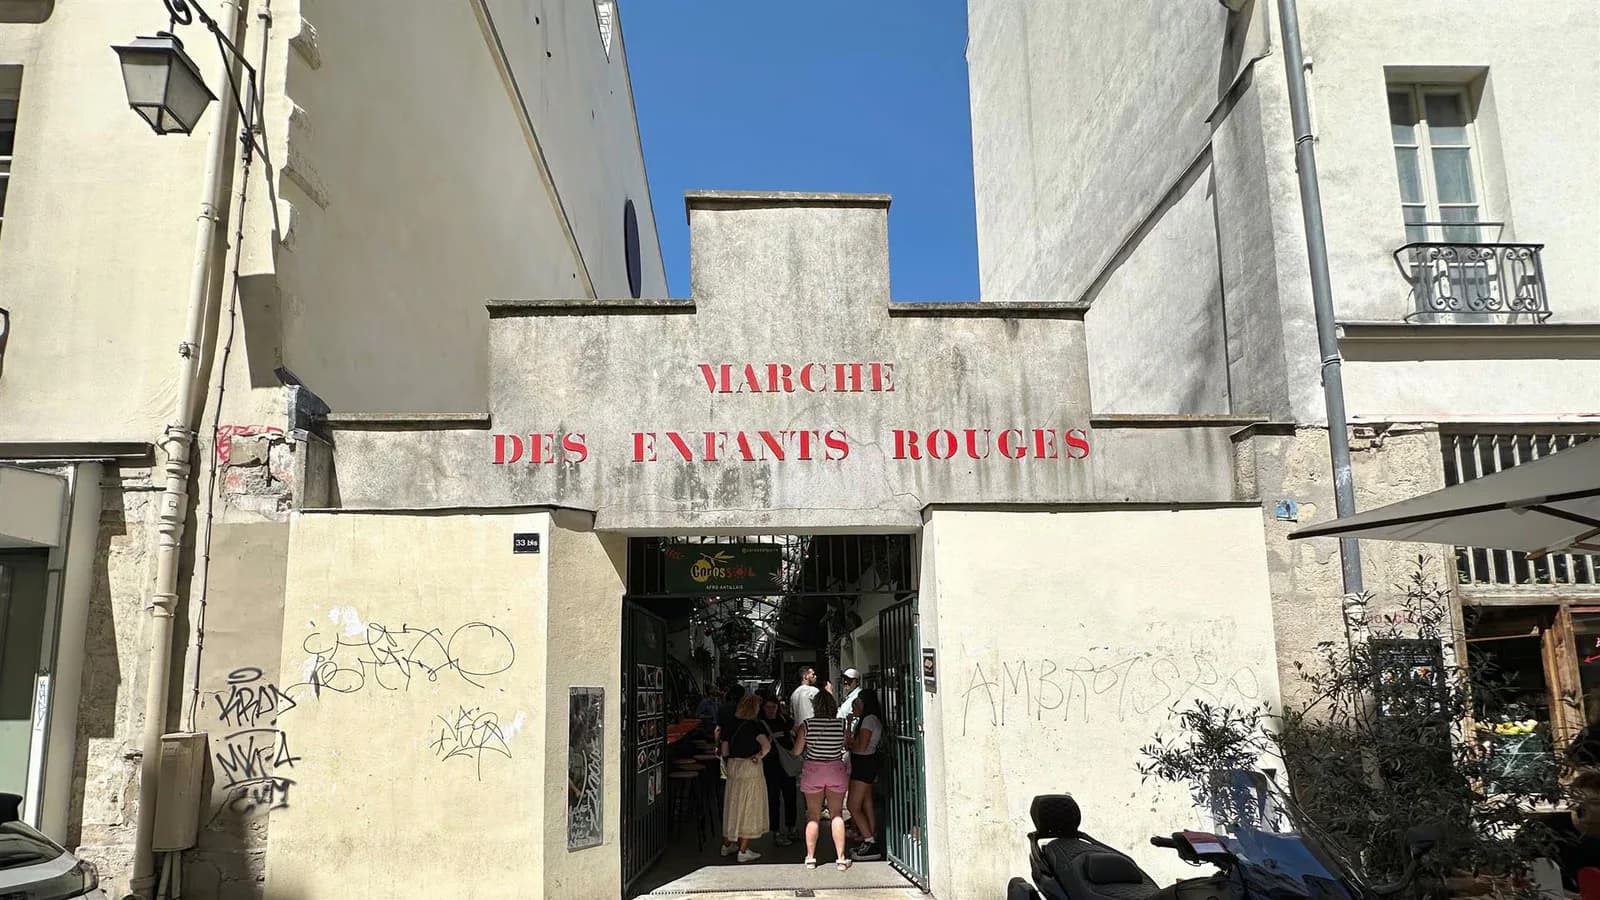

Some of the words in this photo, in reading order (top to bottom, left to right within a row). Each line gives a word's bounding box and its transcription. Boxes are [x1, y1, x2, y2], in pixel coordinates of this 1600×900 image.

[697, 362, 895, 394] MARCHE
[491, 432, 589, 465] DES
[631, 430, 850, 462] ENFANTS
[891, 428, 1091, 461] ROUGES
[515, 538, 526, 547] 33
[527, 538, 538, 547] bis
